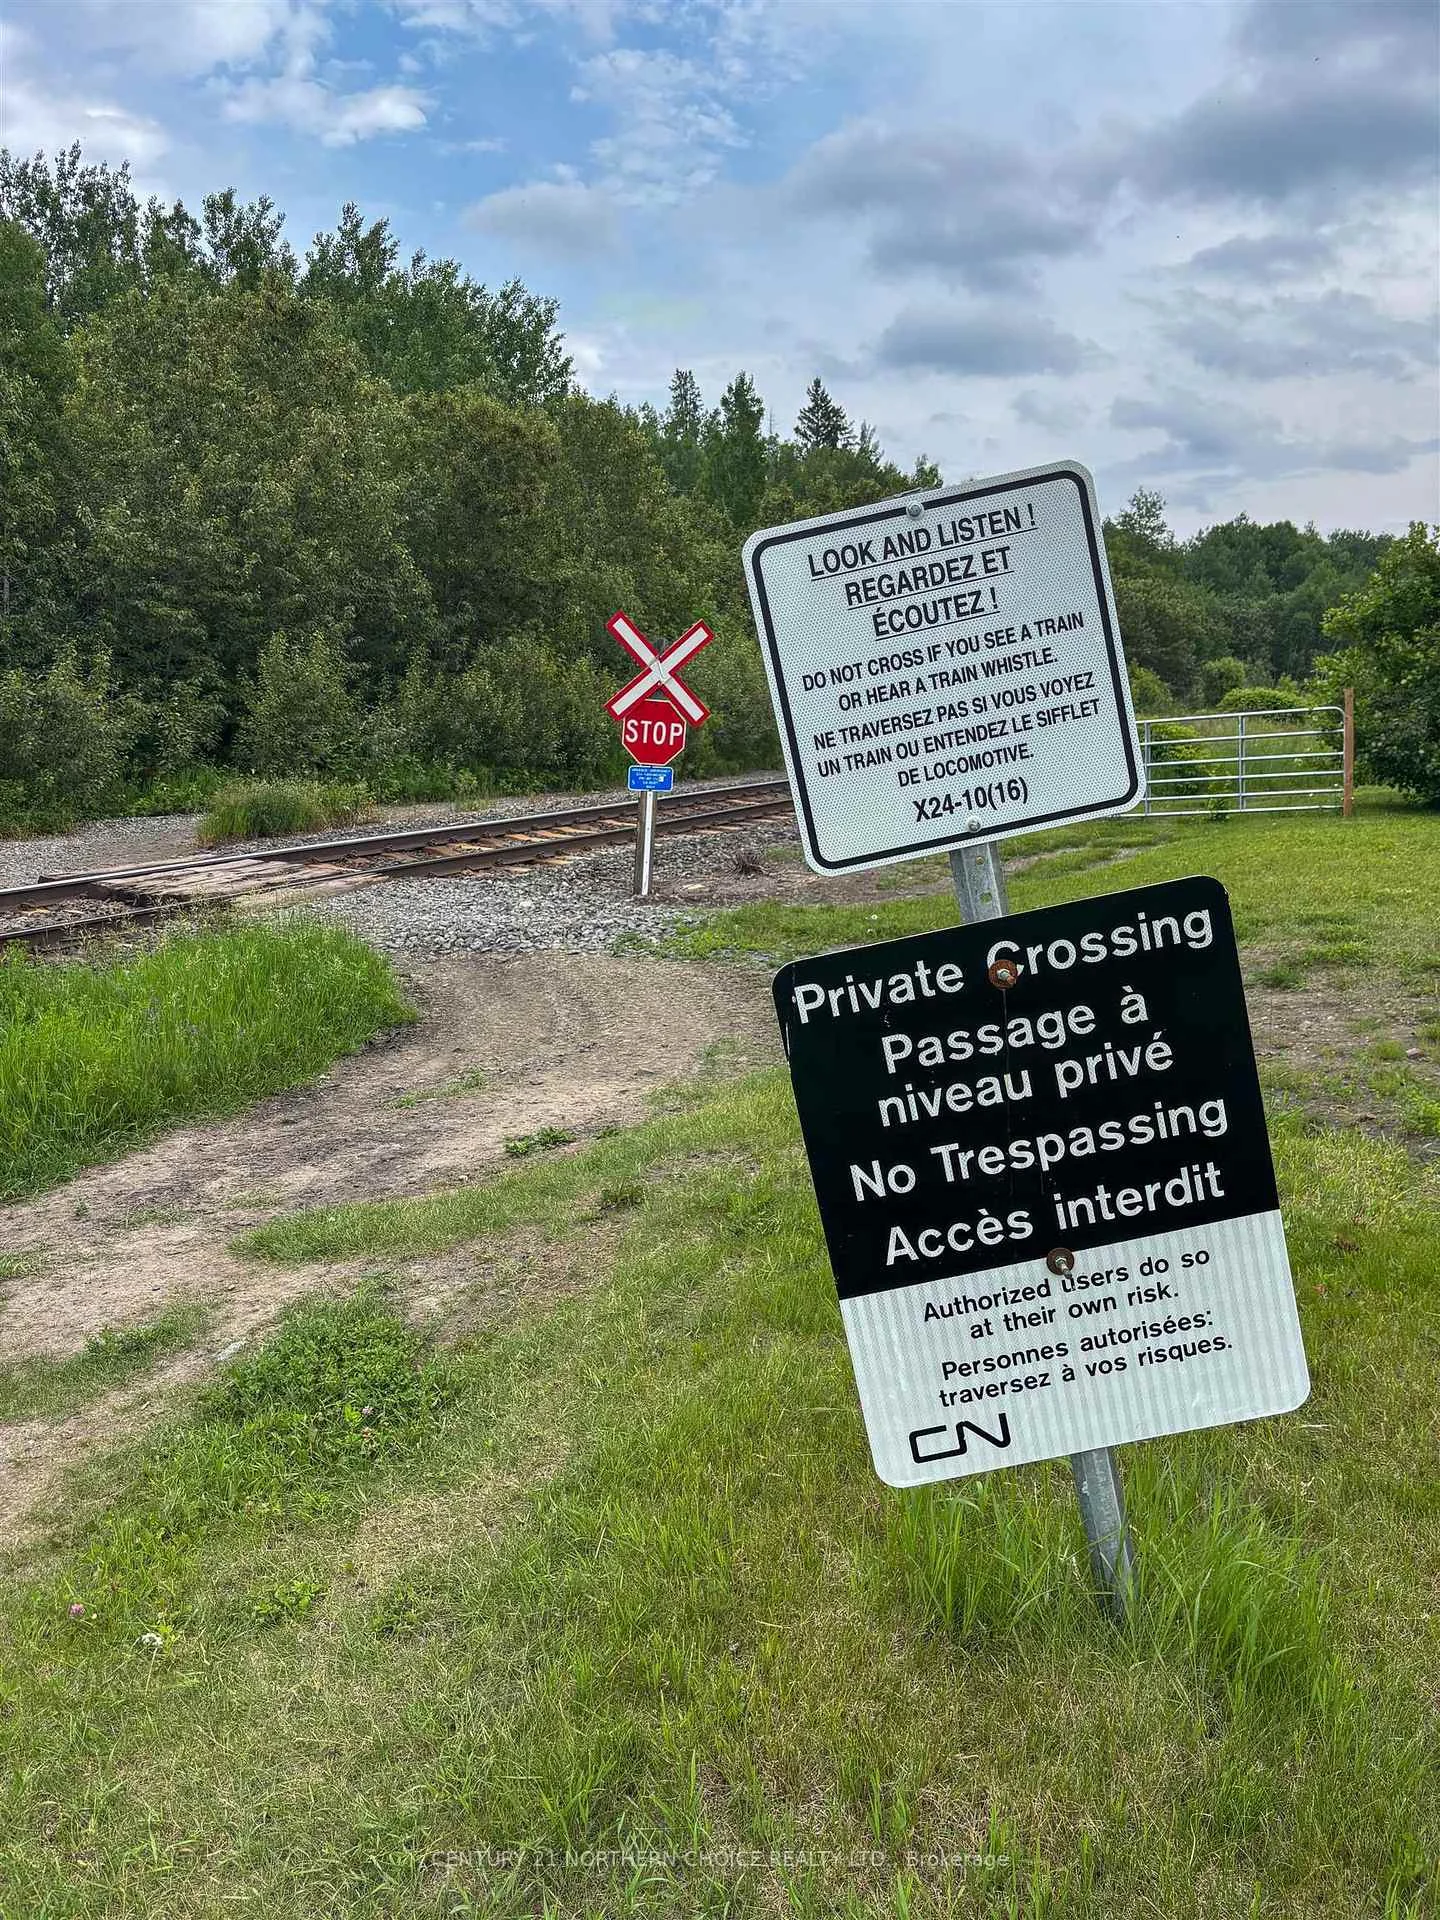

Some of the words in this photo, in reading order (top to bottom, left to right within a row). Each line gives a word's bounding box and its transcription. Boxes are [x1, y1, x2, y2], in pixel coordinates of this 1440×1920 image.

[808, 540, 878, 577] LOOK
[883, 528, 932, 560] AND
[937, 507, 1022, 546] LISTEN
[1028, 503, 1036, 526] !
[845, 555, 978, 606] REGARDEZ
[981, 546, 1011, 574] ET
[872, 590, 985, 637] ÉCOUTEZ
[990, 587, 998, 609] !
[802, 672, 826, 691] DO
[829, 662, 862, 685] NOT
[868, 649, 924, 676] CROSS
[927, 644, 942, 662] IF
[945, 635, 980, 658] YOU
[984, 627, 1017, 649] SEE
[1021, 624, 1032, 641] A
[1034, 612, 1084, 637] TRAIN
[839, 692, 862, 711] OR
[866, 681, 911, 705] HEAR
[916, 677, 927, 694] A
[928, 665, 978, 689] TRAIN
[981, 647, 1057, 677] WHISTLE.
[625, 719, 683, 746] STOP
[814, 731, 836, 750] NE
[838, 708, 934, 744] TRAVERSEZ
[937, 701, 969, 722] PAS
[972, 696, 987, 713] SI
[991, 685, 1037, 709] VOUS
[1040, 672, 1095, 698] VOYEZ
[818, 758, 840, 777] UN
[843, 747, 892, 771] TRAIN
[896, 740, 919, 759] OU
[923, 720, 1009, 753] ENTENDEZ
[1012, 714, 1033, 733] LE
[1036, 698, 1099, 727] SIFFLET
[898, 768, 920, 787] DE
[924, 743, 1034, 781] LOCOMOTIVE.
[913, 777, 1028, 822] X24-10(16)
[793, 960, 964, 1024] Private
[987, 909, 1213, 977] Crossing
[882, 1005, 1097, 1073] Passage
[1121, 985, 1149, 1024] à
[879, 1069, 1032, 1127] niveau
[1055, 1031, 1174, 1098] privé
[850, 1160, 916, 1202] No
[930, 1098, 1228, 1182] Trespassing
[885, 1208, 1033, 1265] Accès
[1053, 1161, 1225, 1230] interdit
[924, 1277, 1051, 1322] Authorized
[1061, 1267, 1129, 1293] users
[1140, 1257, 1169, 1276] do
[1181, 1251, 1210, 1268] so
[970, 1318, 993, 1340] at
[1003, 1306, 1056, 1331] their
[1068, 1297, 1117, 1319] own
[1127, 1282, 1178, 1307] risk.
[939, 1367, 1051, 1407] traversez
[1062, 1362, 1076, 1382] à
[1084, 1356, 1128, 1377] vos
[1138, 1337, 1232, 1367] risques.
[941, 1342, 1068, 1380] Personnes
[1080, 1309, 1213, 1352] autorisées:
[908, 1412, 1012, 1464] CN
